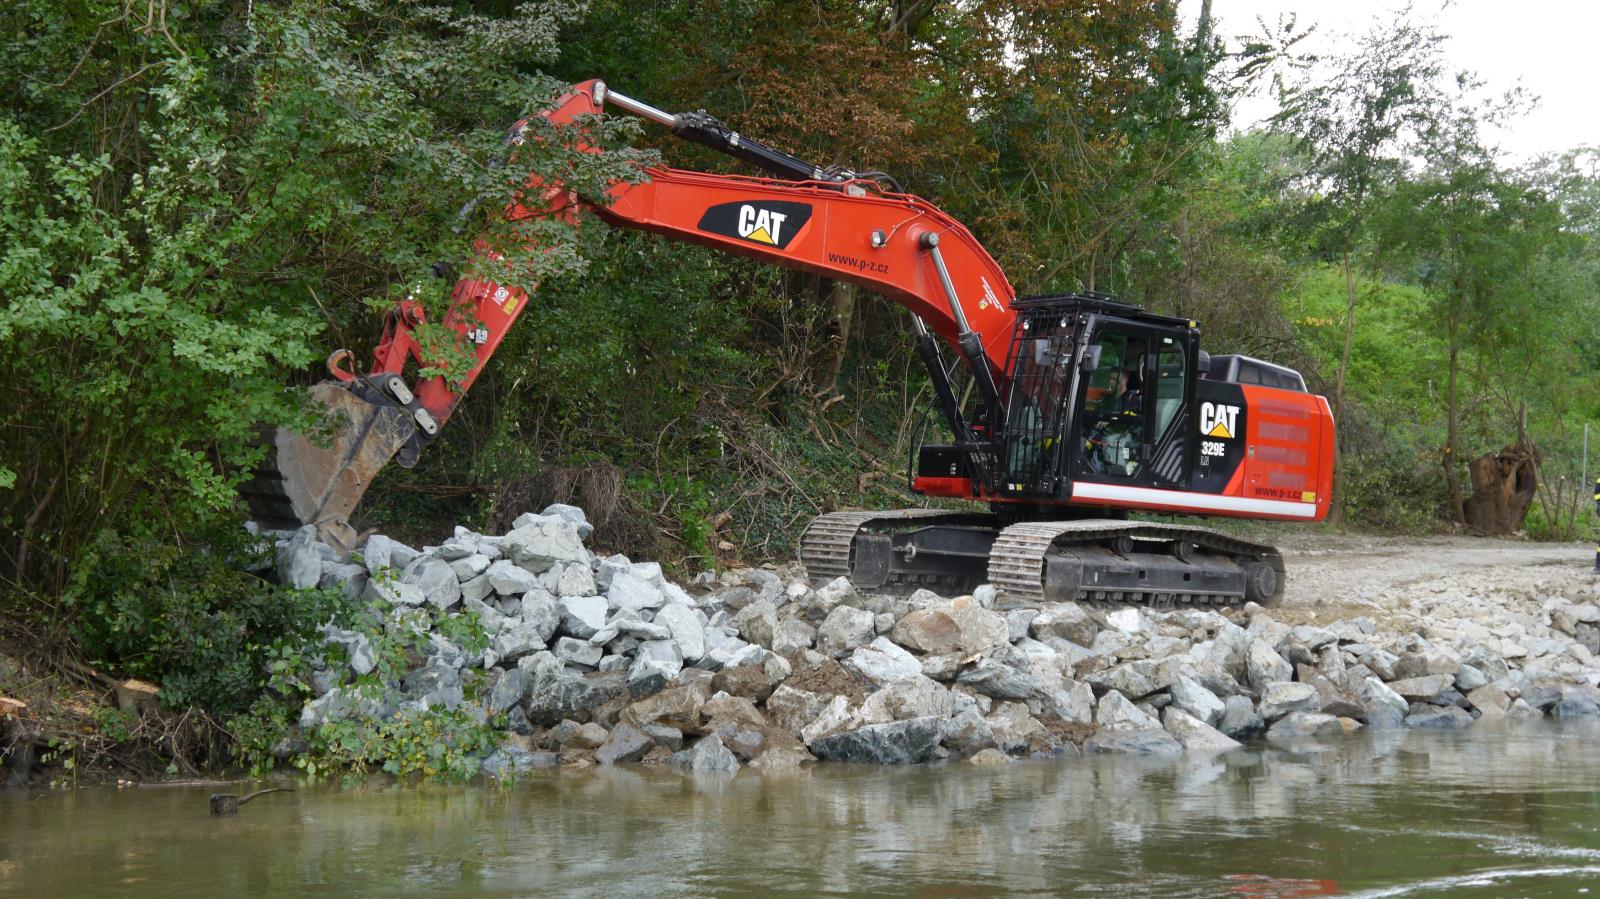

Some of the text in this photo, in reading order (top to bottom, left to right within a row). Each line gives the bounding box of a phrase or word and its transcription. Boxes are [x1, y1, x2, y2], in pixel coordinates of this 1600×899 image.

[738, 204, 787, 245] CAT
[829, 253, 889, 273] www.p-z.cz
[1200, 402, 1239, 438] CAT
[1201, 442, 1225, 456] 329E
